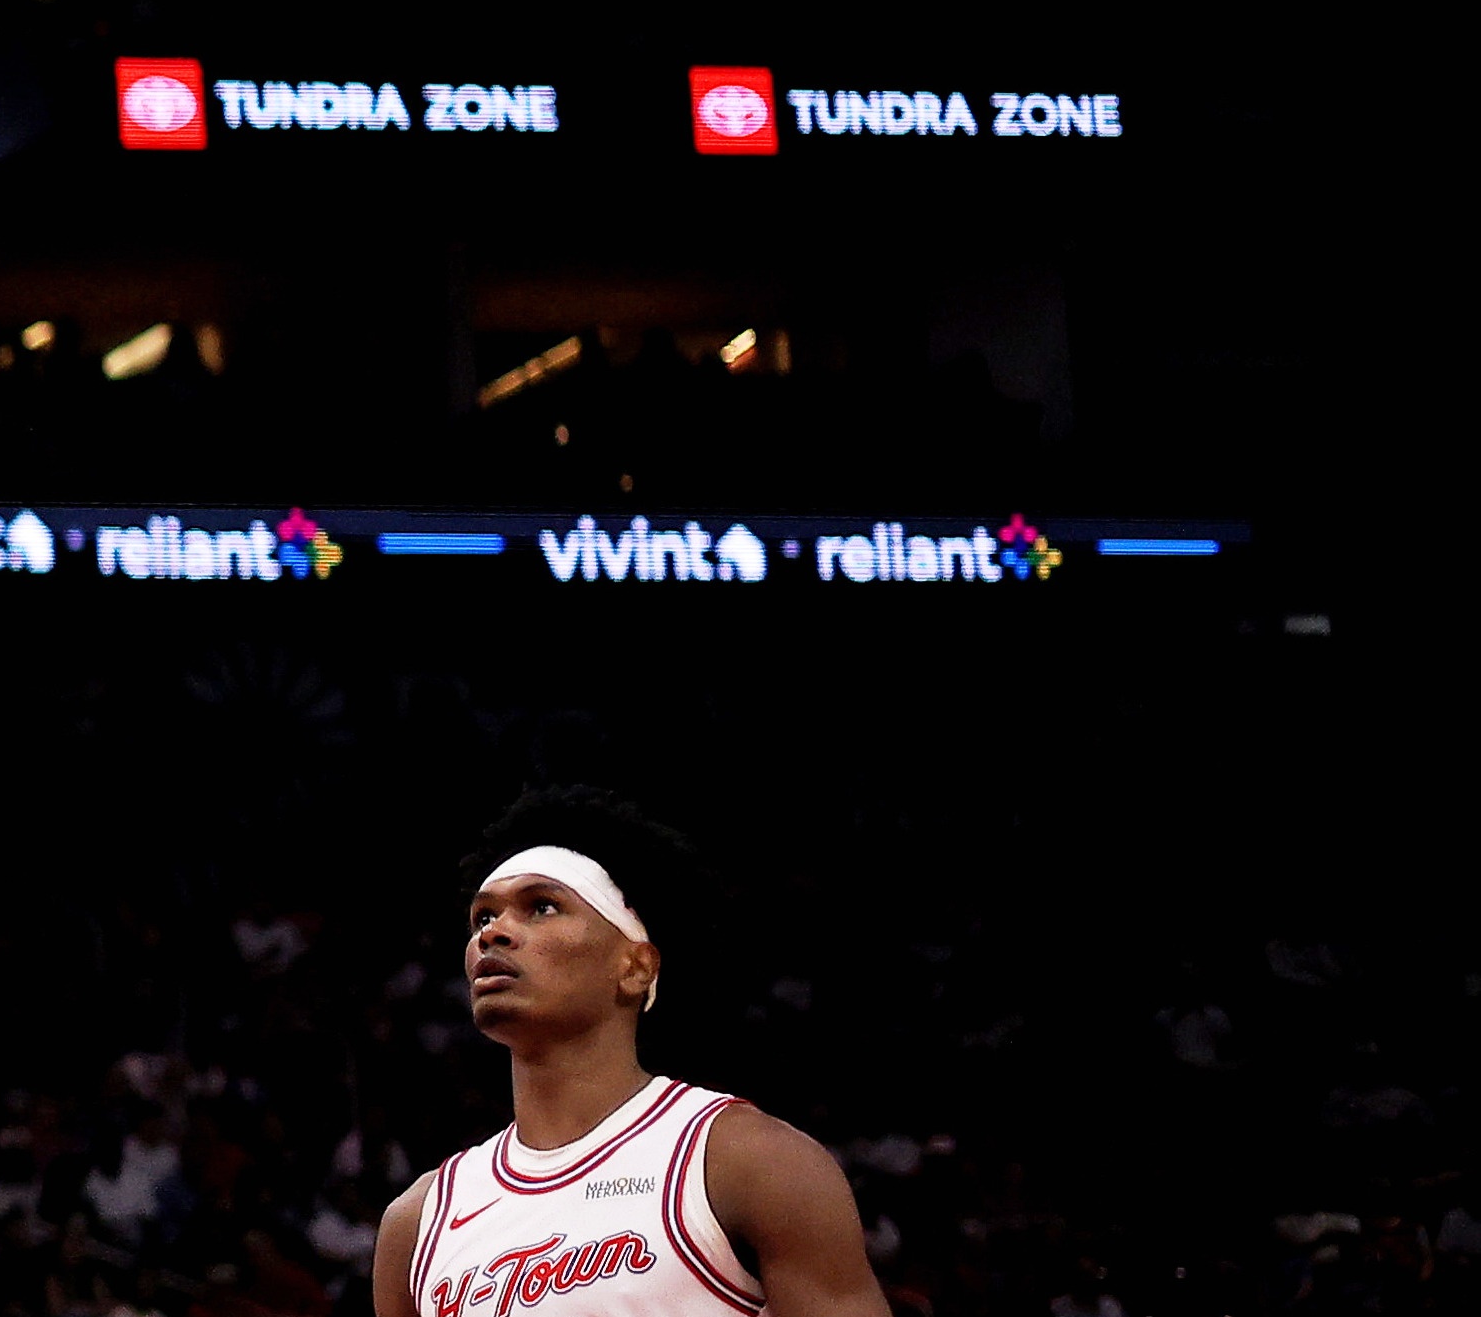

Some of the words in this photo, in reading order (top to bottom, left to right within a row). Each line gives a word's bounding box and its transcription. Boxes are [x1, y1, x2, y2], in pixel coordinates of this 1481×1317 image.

[214, 81, 410, 130] TUNDRA
[422, 83, 559, 132] ZONE
[788, 89, 978, 136] TUNDRA
[991, 92, 1122, 137] ZONE
[97, 515, 281, 581] reliant
[539, 514, 709, 582] vivint
[816, 522, 1003, 583] reliant
